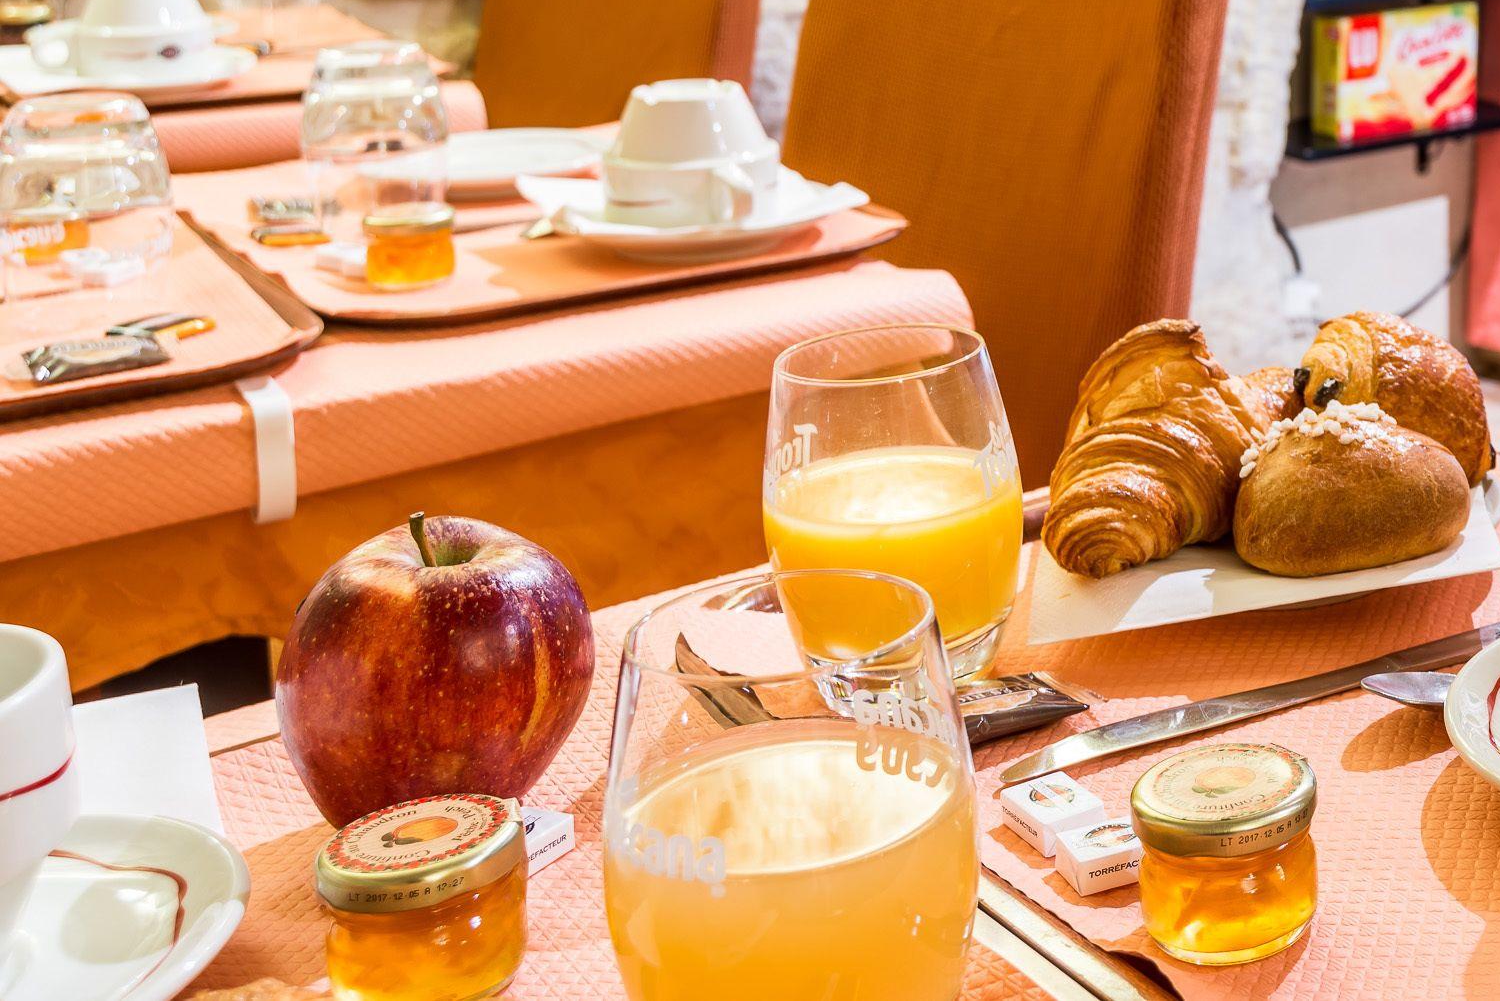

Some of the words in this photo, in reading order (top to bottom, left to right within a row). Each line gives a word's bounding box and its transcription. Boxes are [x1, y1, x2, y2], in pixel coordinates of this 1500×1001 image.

[1220, 837, 1233, 847] LT
[1089, 859, 1140, 879] TORRÉFAC
[349, 893, 360, 902] LT
